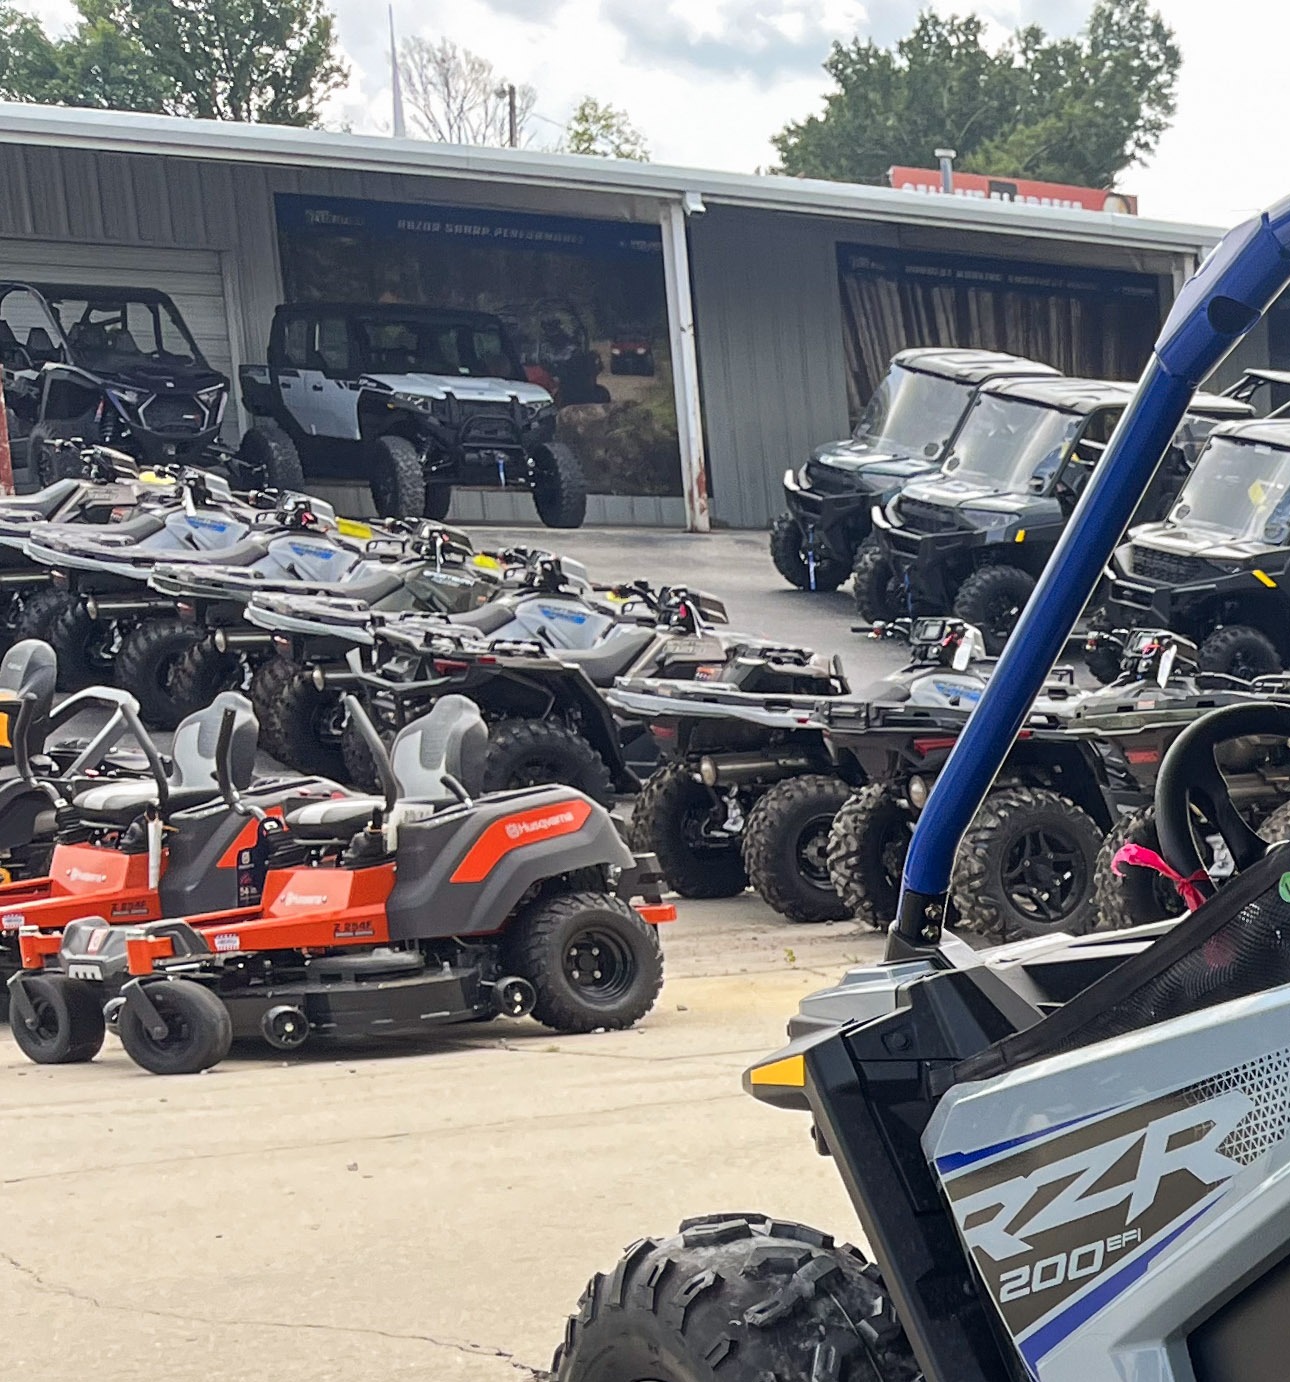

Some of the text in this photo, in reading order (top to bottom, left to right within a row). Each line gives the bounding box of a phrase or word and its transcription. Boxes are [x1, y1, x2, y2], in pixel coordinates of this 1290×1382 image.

[518, 811, 575, 835] Husqvarna
[950, 1088, 1258, 1262] RZR
[1000, 1239, 1105, 1304] 200
